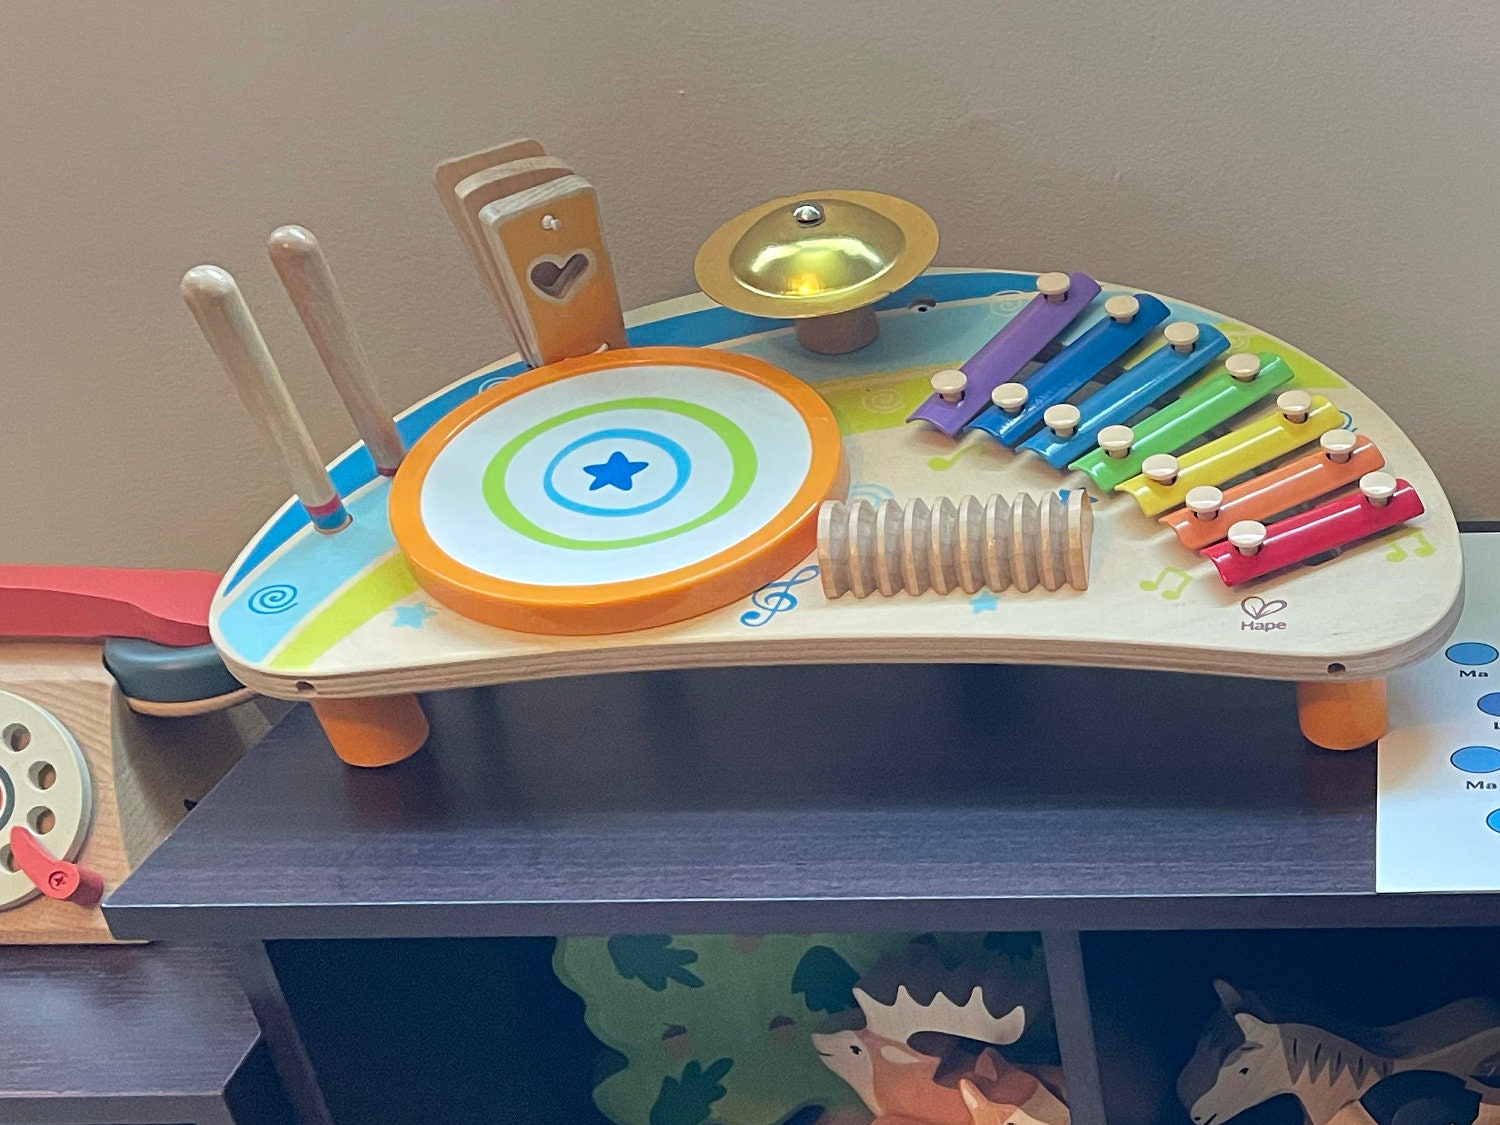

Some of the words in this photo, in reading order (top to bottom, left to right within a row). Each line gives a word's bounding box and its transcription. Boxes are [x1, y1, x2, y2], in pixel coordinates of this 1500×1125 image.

[1241, 621, 1287, 632] Hape
[1459, 669, 1489, 678] Ma
[1466, 780, 1498, 790] Ma
